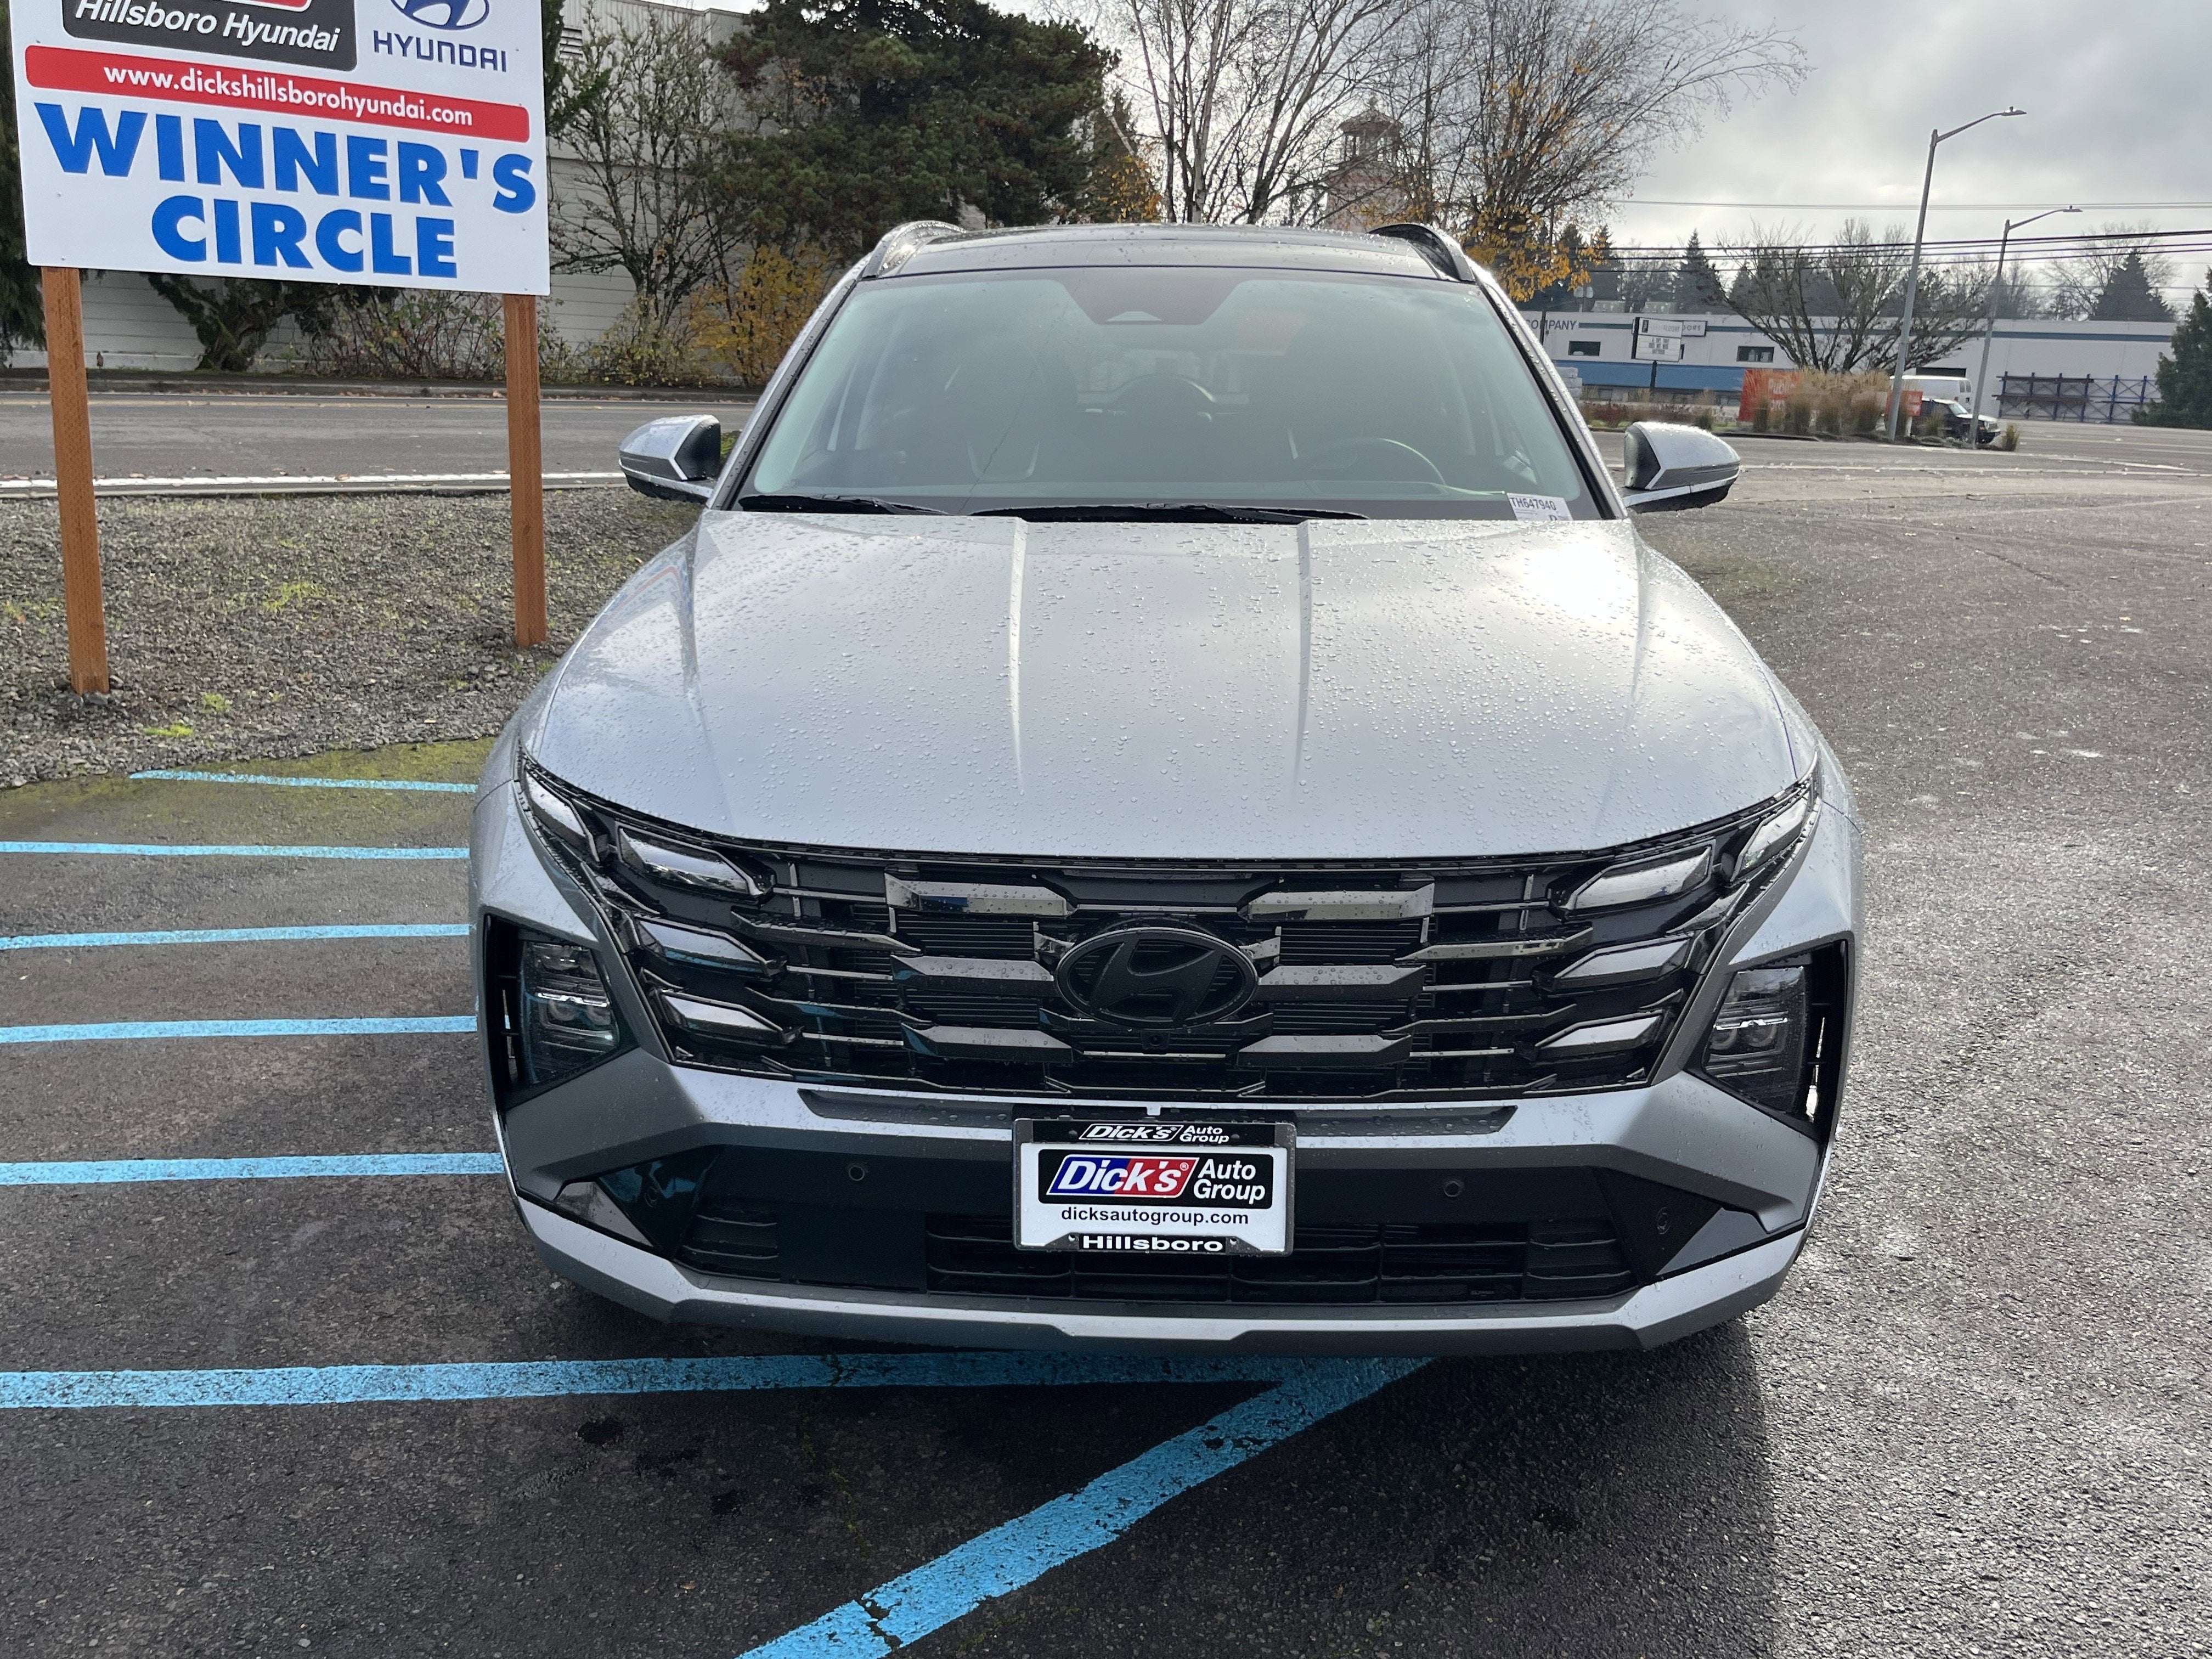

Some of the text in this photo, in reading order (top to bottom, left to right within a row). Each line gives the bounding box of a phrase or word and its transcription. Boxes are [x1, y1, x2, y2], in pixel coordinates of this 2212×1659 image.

[75, 0, 341, 52] Hillsboro Hyundai
[373, 30, 506, 72] HYUNDAI
[104, 66, 473, 126] www.dickshillsborohyundai.com
[34, 102, 537, 214] WINNER'S
[151, 195, 458, 279] CIRCLE
[1509, 497, 1556, 511] TH647940
[1180, 1133, 1229, 1144] Group
[1183, 1125, 1223, 1135] Auto
[1198, 1158, 1256, 1180] Auto
[1193, 1178, 1266, 1205] Group
[1061, 1206, 1249, 1226] dicksautogroup.com
[1082, 1235, 1223, 1252] Hillsboro
